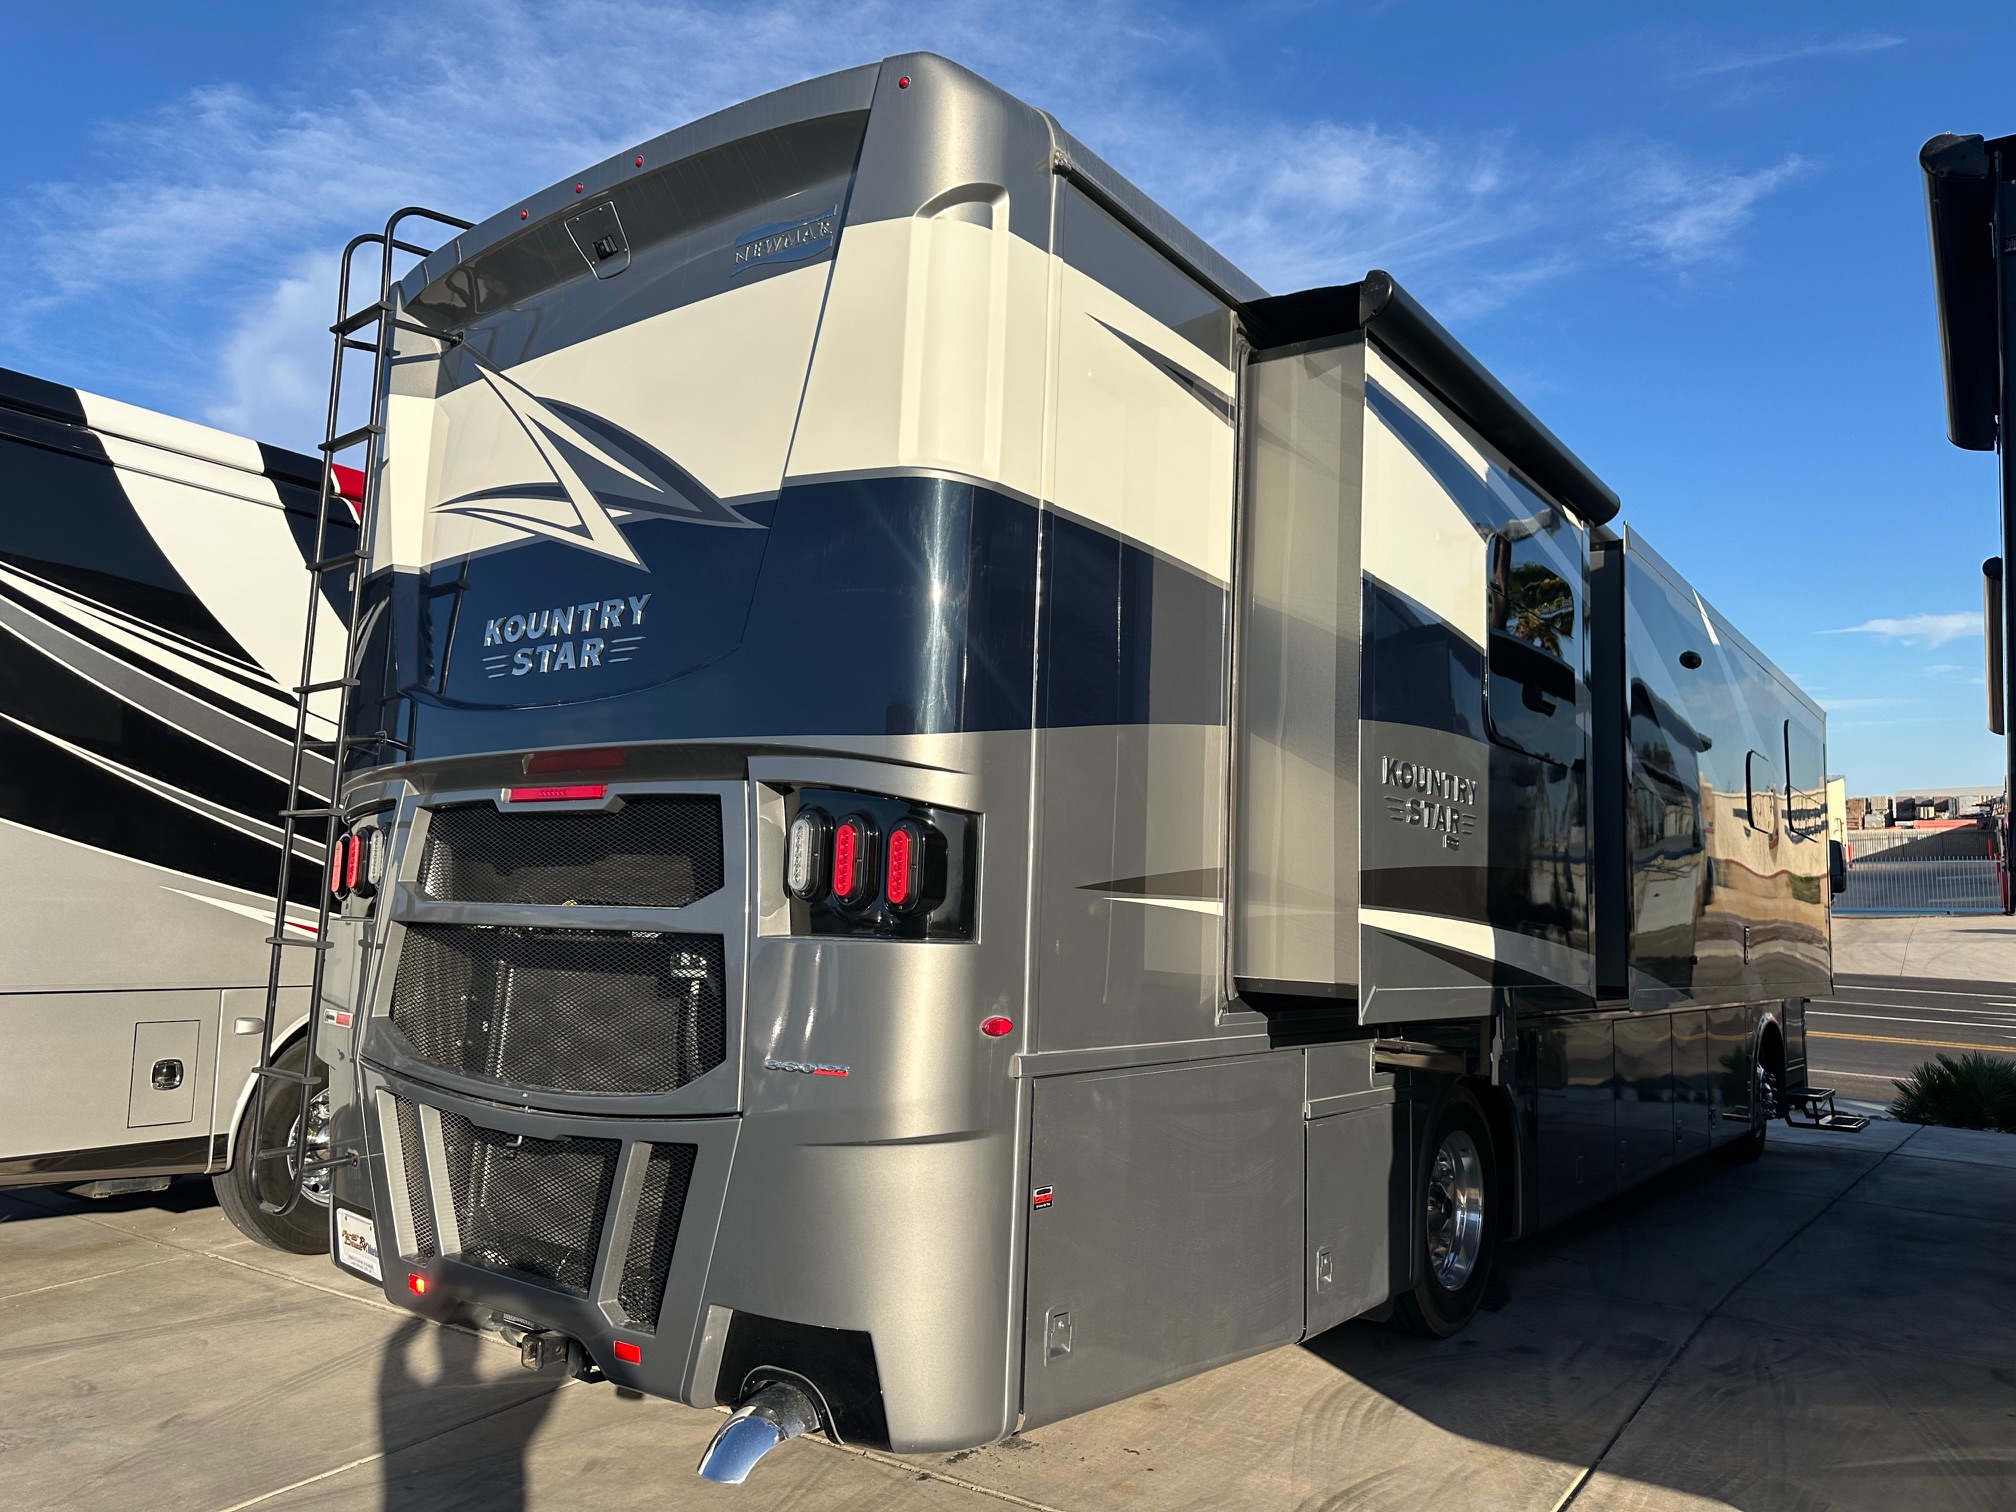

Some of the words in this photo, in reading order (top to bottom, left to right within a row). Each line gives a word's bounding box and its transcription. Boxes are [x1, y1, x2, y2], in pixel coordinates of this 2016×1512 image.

[735, 221, 834, 264] NEWMAR
[483, 593, 652, 647] KOUNTRY
[511, 637, 605, 676] STAR
[1382, 755, 1478, 805] KOUNTRY
[1405, 797, 1460, 834] STAR
